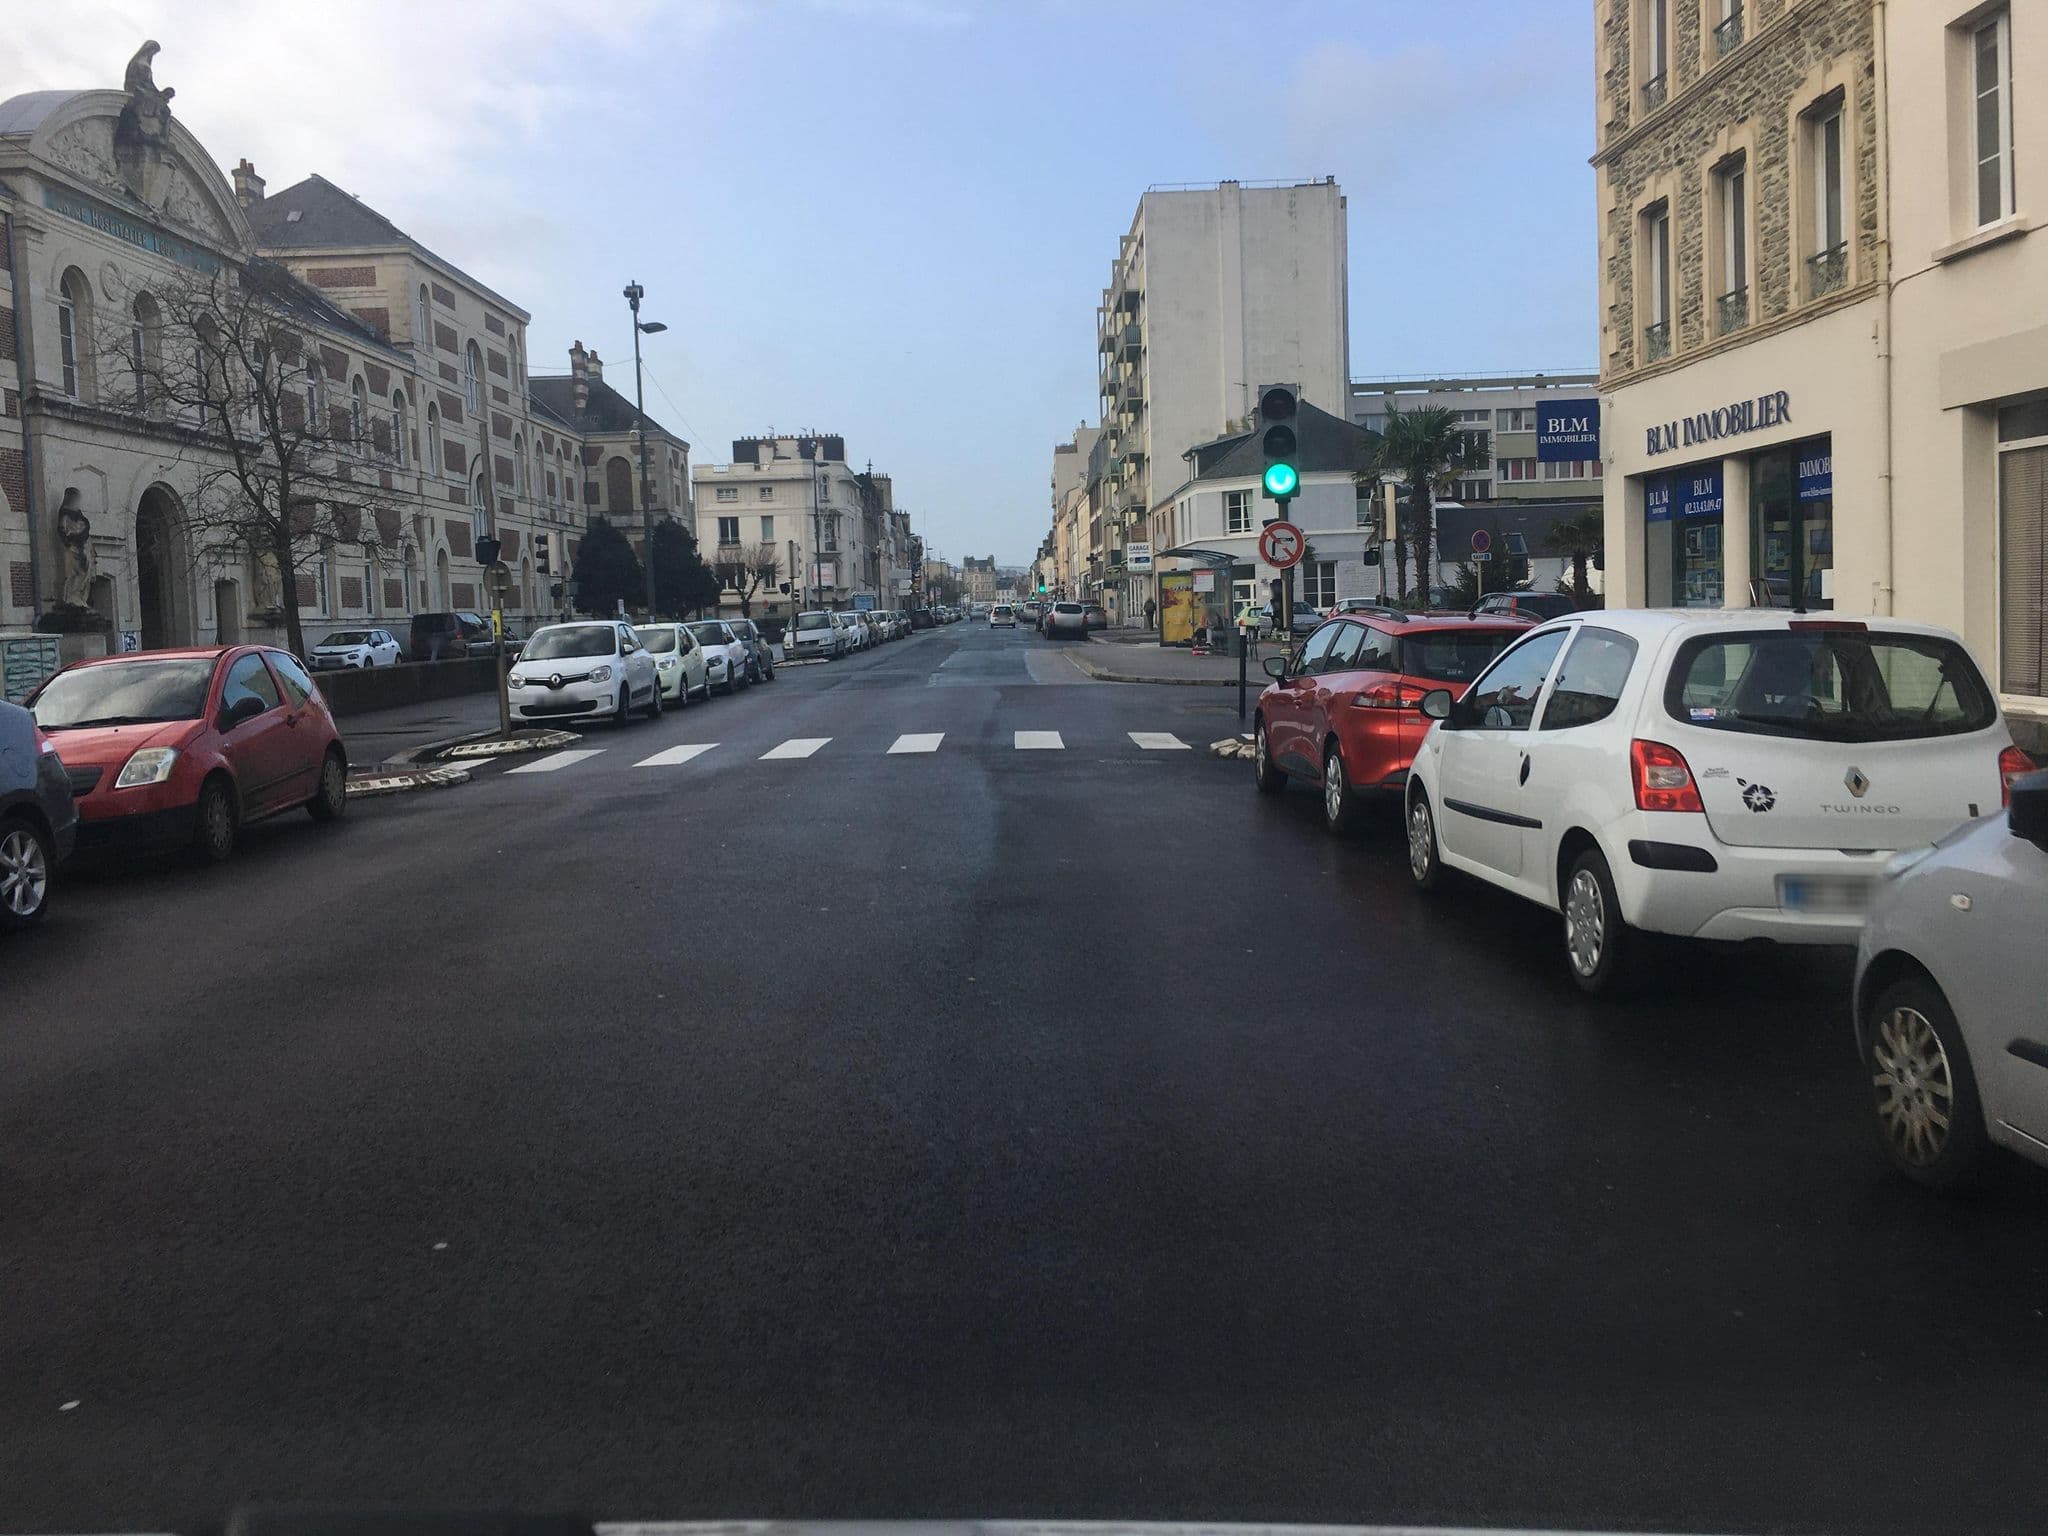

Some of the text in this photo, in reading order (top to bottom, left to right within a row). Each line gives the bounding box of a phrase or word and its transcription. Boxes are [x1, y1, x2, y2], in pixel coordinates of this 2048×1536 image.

[1547, 417, 1589, 433] BLM
[1646, 390, 1792, 456] BLM IMMOBILIER
[1540, 434, 1597, 444] IMMOBILIER
[1693, 478, 1713, 497] BLM
[1820, 804, 1901, 814] TWINGO
